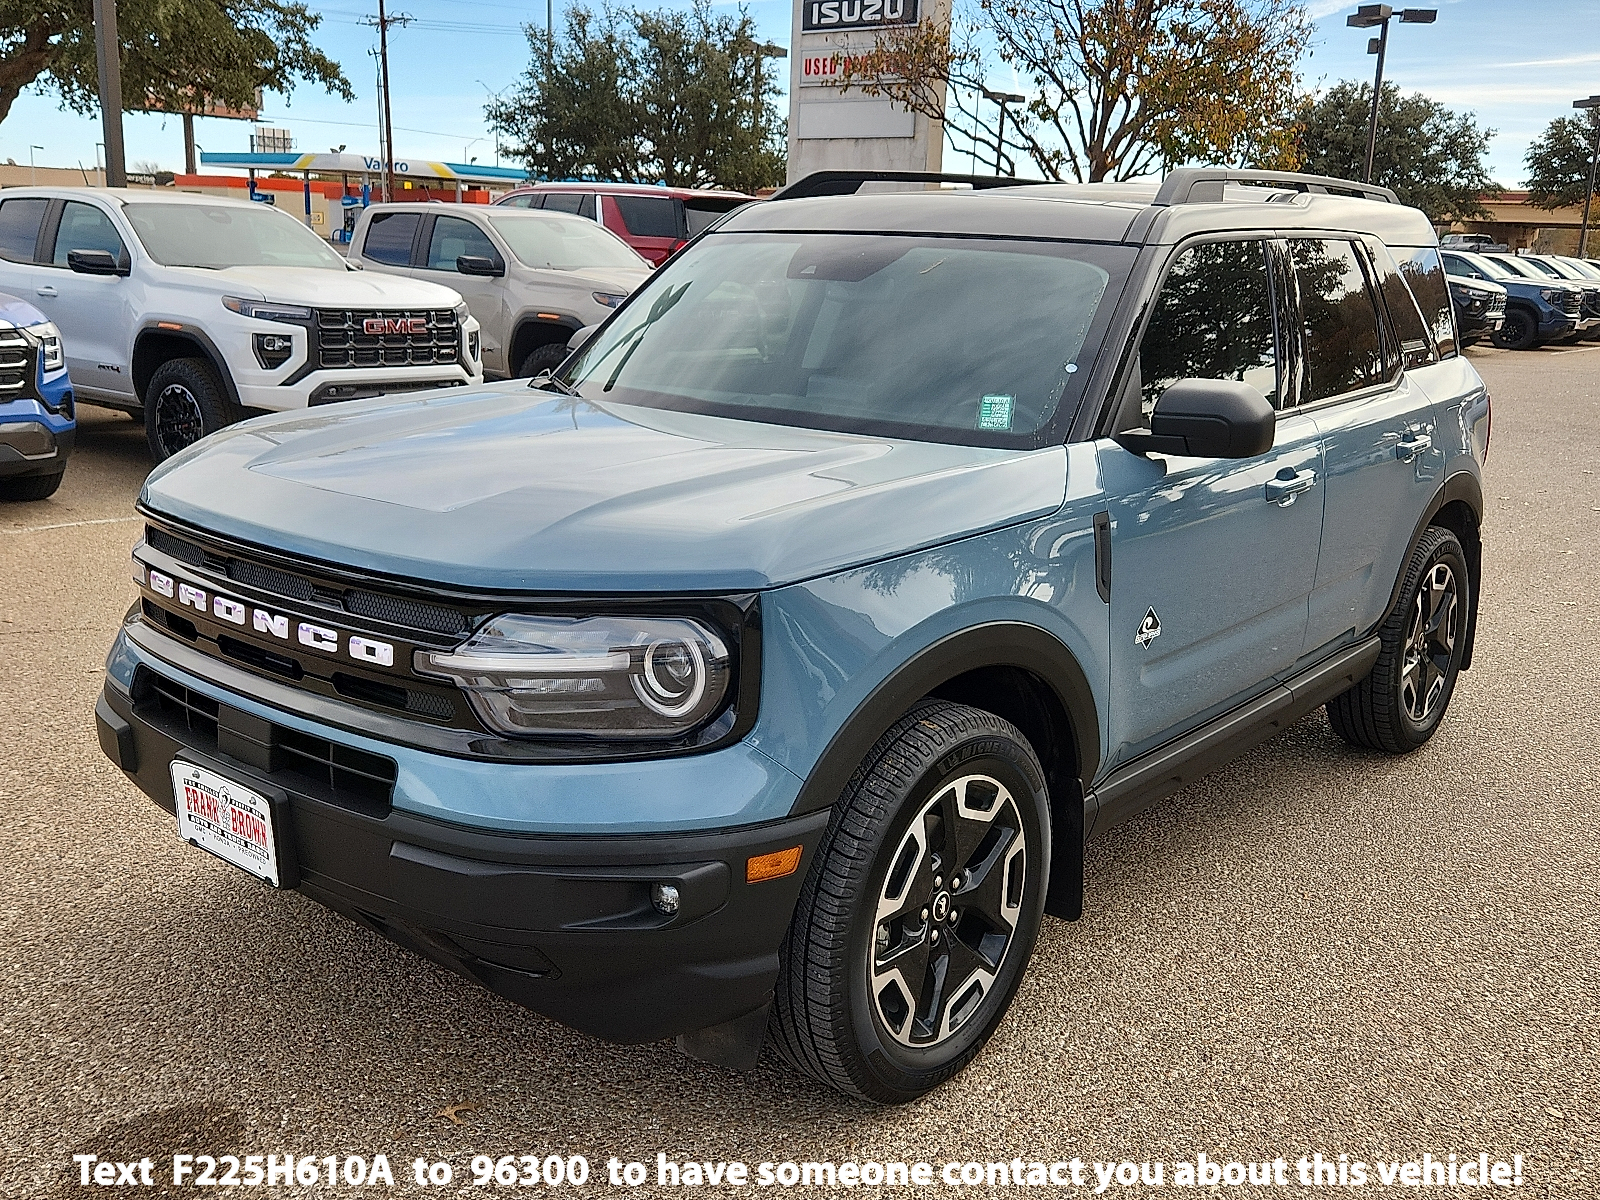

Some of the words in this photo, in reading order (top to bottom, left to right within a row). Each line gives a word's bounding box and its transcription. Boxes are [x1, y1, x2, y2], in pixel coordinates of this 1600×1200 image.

[811, 0, 904, 25] ISUZU
[804, 57, 837, 76] USED
[363, 156, 409, 173] Varo
[363, 318, 428, 335] GMC
[150, 569, 394, 667] BRONCO
[184, 786, 220, 824] FRANK
[230, 806, 268, 850] BROWN
